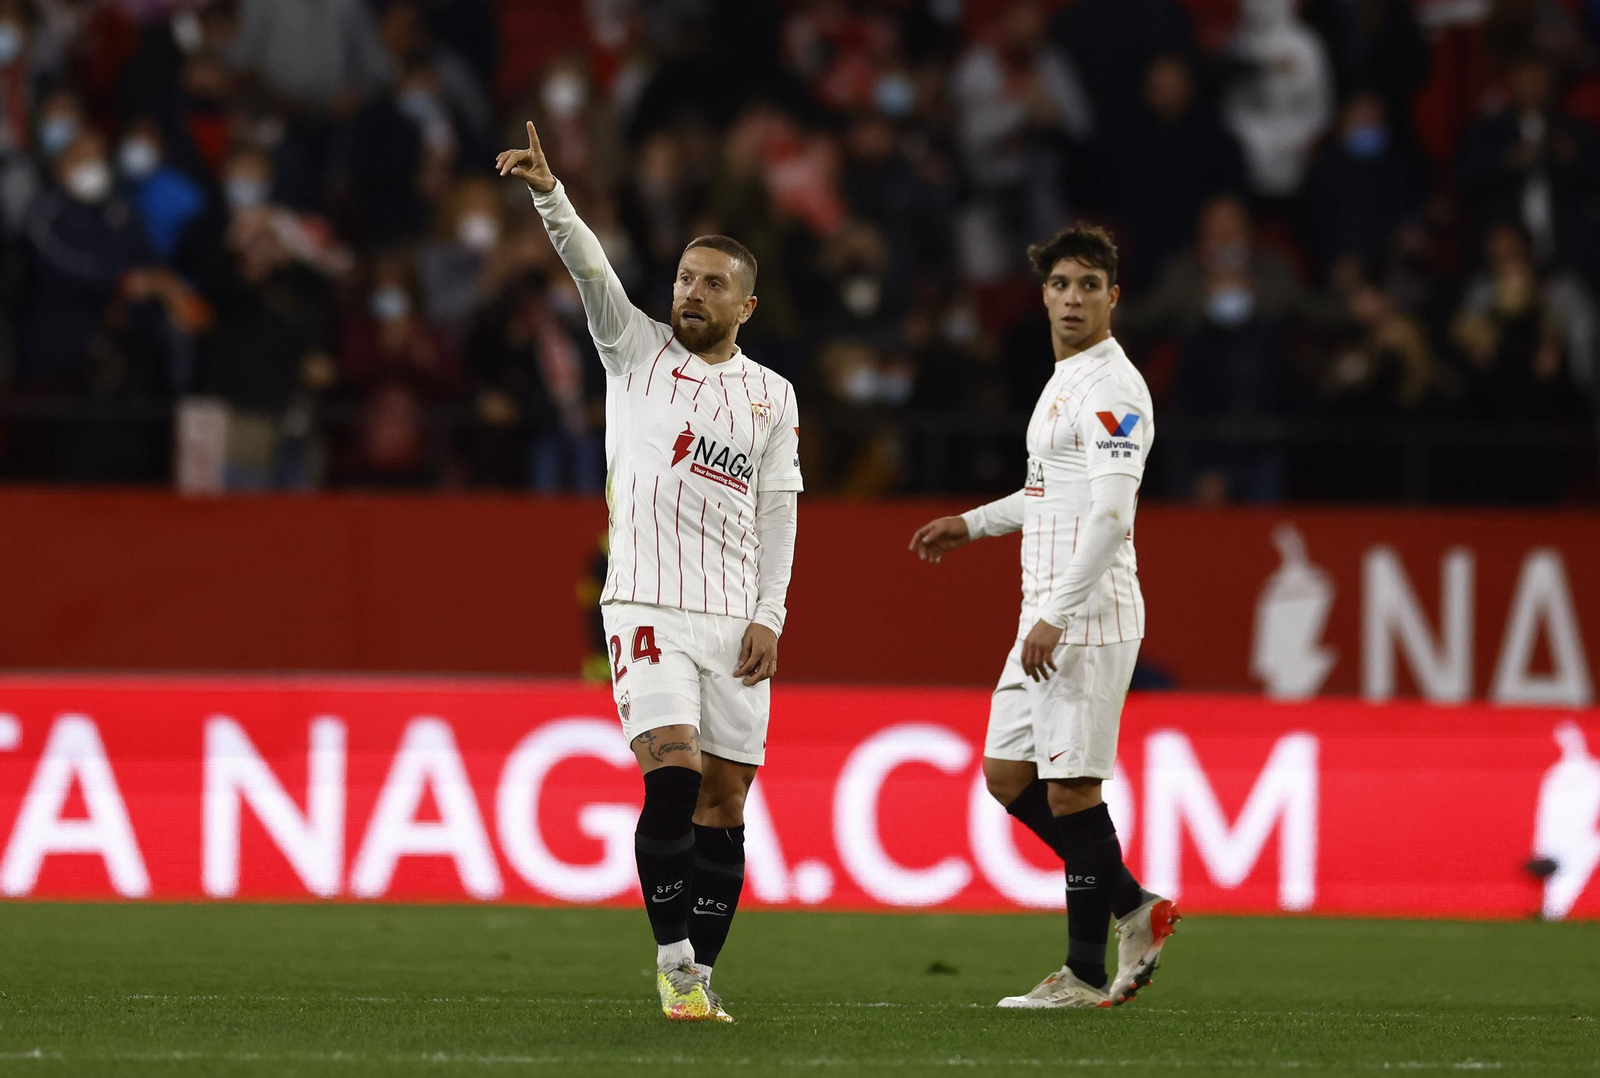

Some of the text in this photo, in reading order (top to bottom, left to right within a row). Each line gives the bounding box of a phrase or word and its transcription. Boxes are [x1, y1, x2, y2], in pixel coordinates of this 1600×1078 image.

[1095, 440, 1141, 452] Valvoline
[693, 436, 754, 483] NAGA
[694, 465, 706, 475] Your
[706, 470, 728, 485] Investing
[609, 626, 662, 686] 24
[0, 712, 153, 898] A
[656, 880, 683, 893] SFC
[697, 897, 727, 911] SFC
